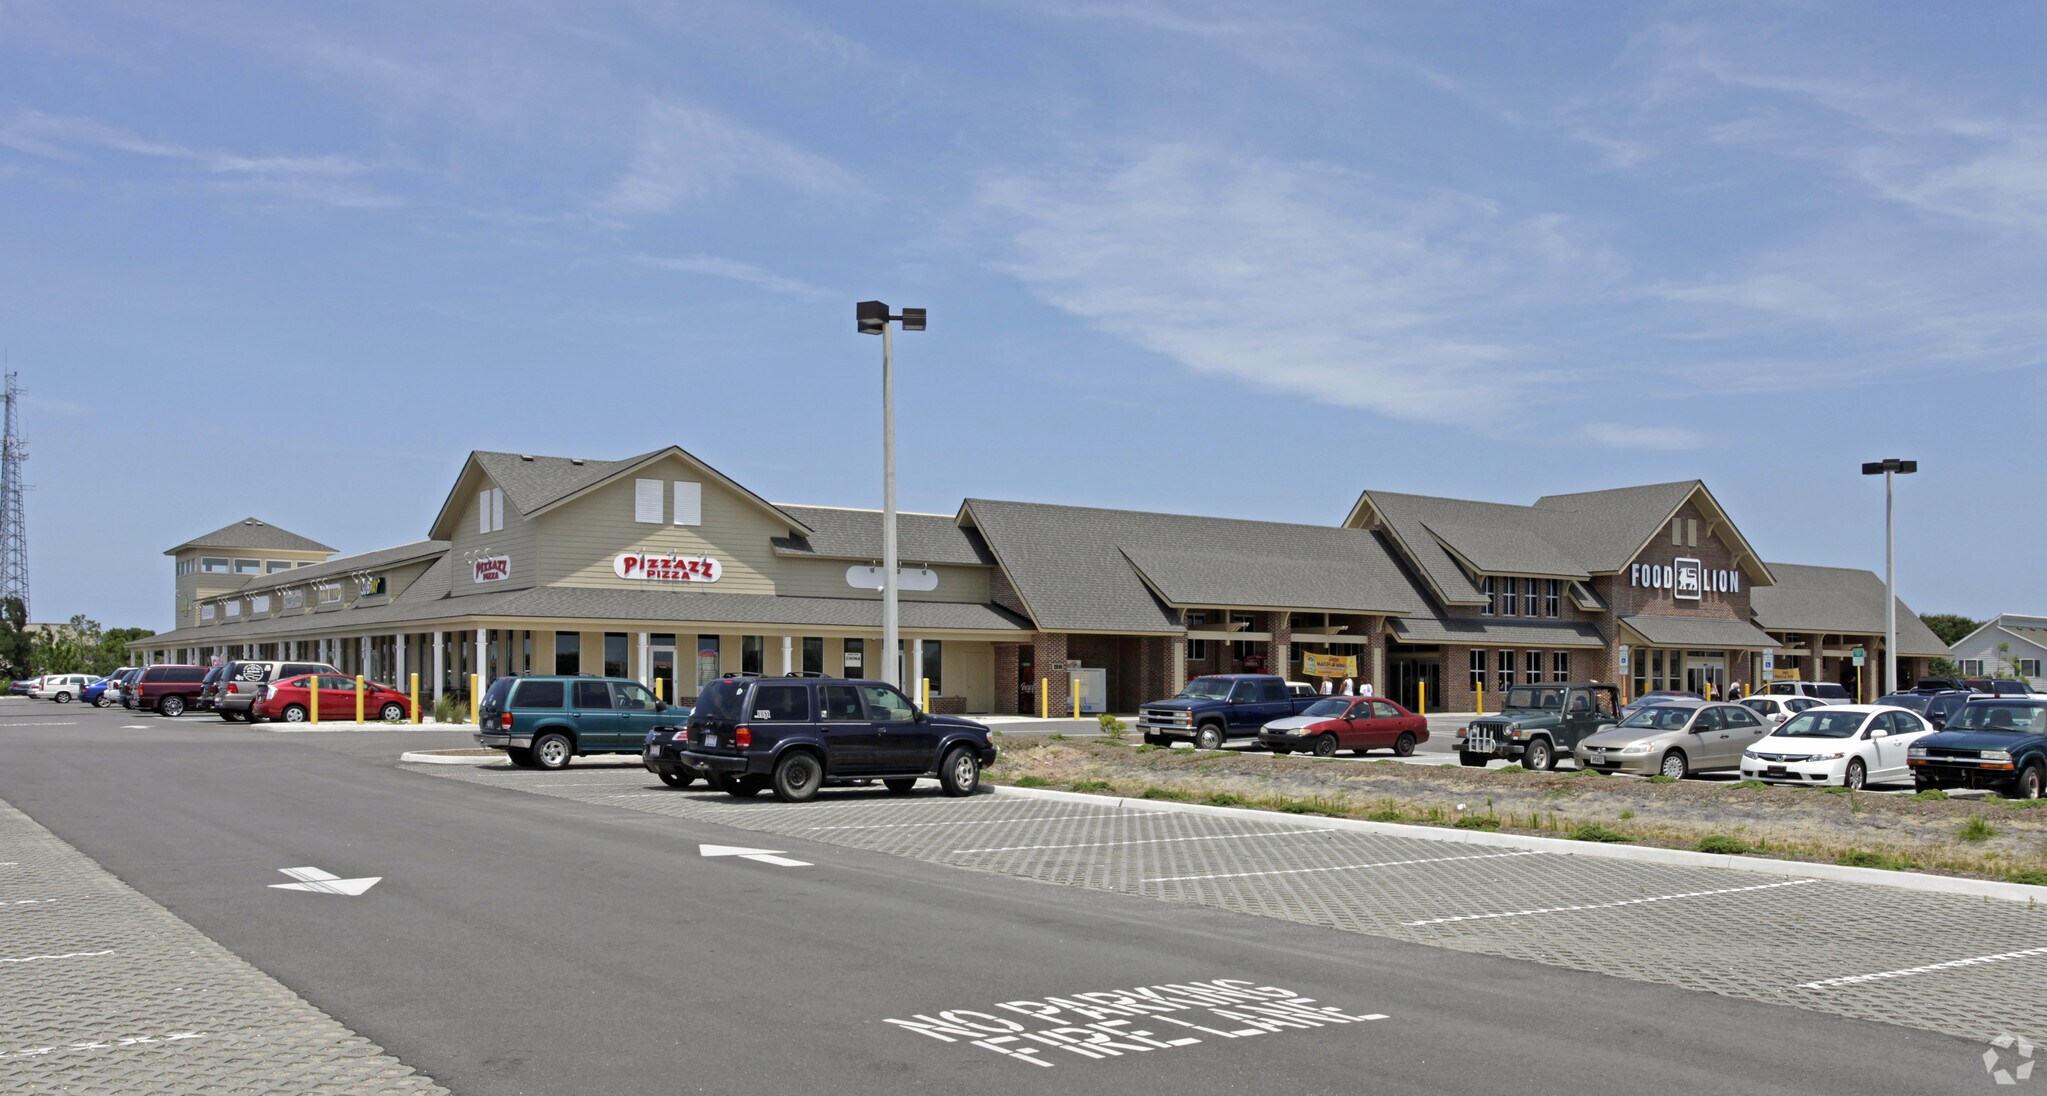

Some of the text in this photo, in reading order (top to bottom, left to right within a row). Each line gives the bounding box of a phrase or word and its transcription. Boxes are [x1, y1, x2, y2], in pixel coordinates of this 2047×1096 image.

[475, 560, 507, 579] PIZZAZZ
[483, 571, 499, 580] PIZZA
[623, 557, 713, 579] PIZZAZZ
[647, 570, 691, 580] PIZZA
[1631, 563, 1739, 593] FOOD LION
[882, 979, 1299, 1042] NO PARKING
[969, 998, 1391, 1068] FIRE LANE
